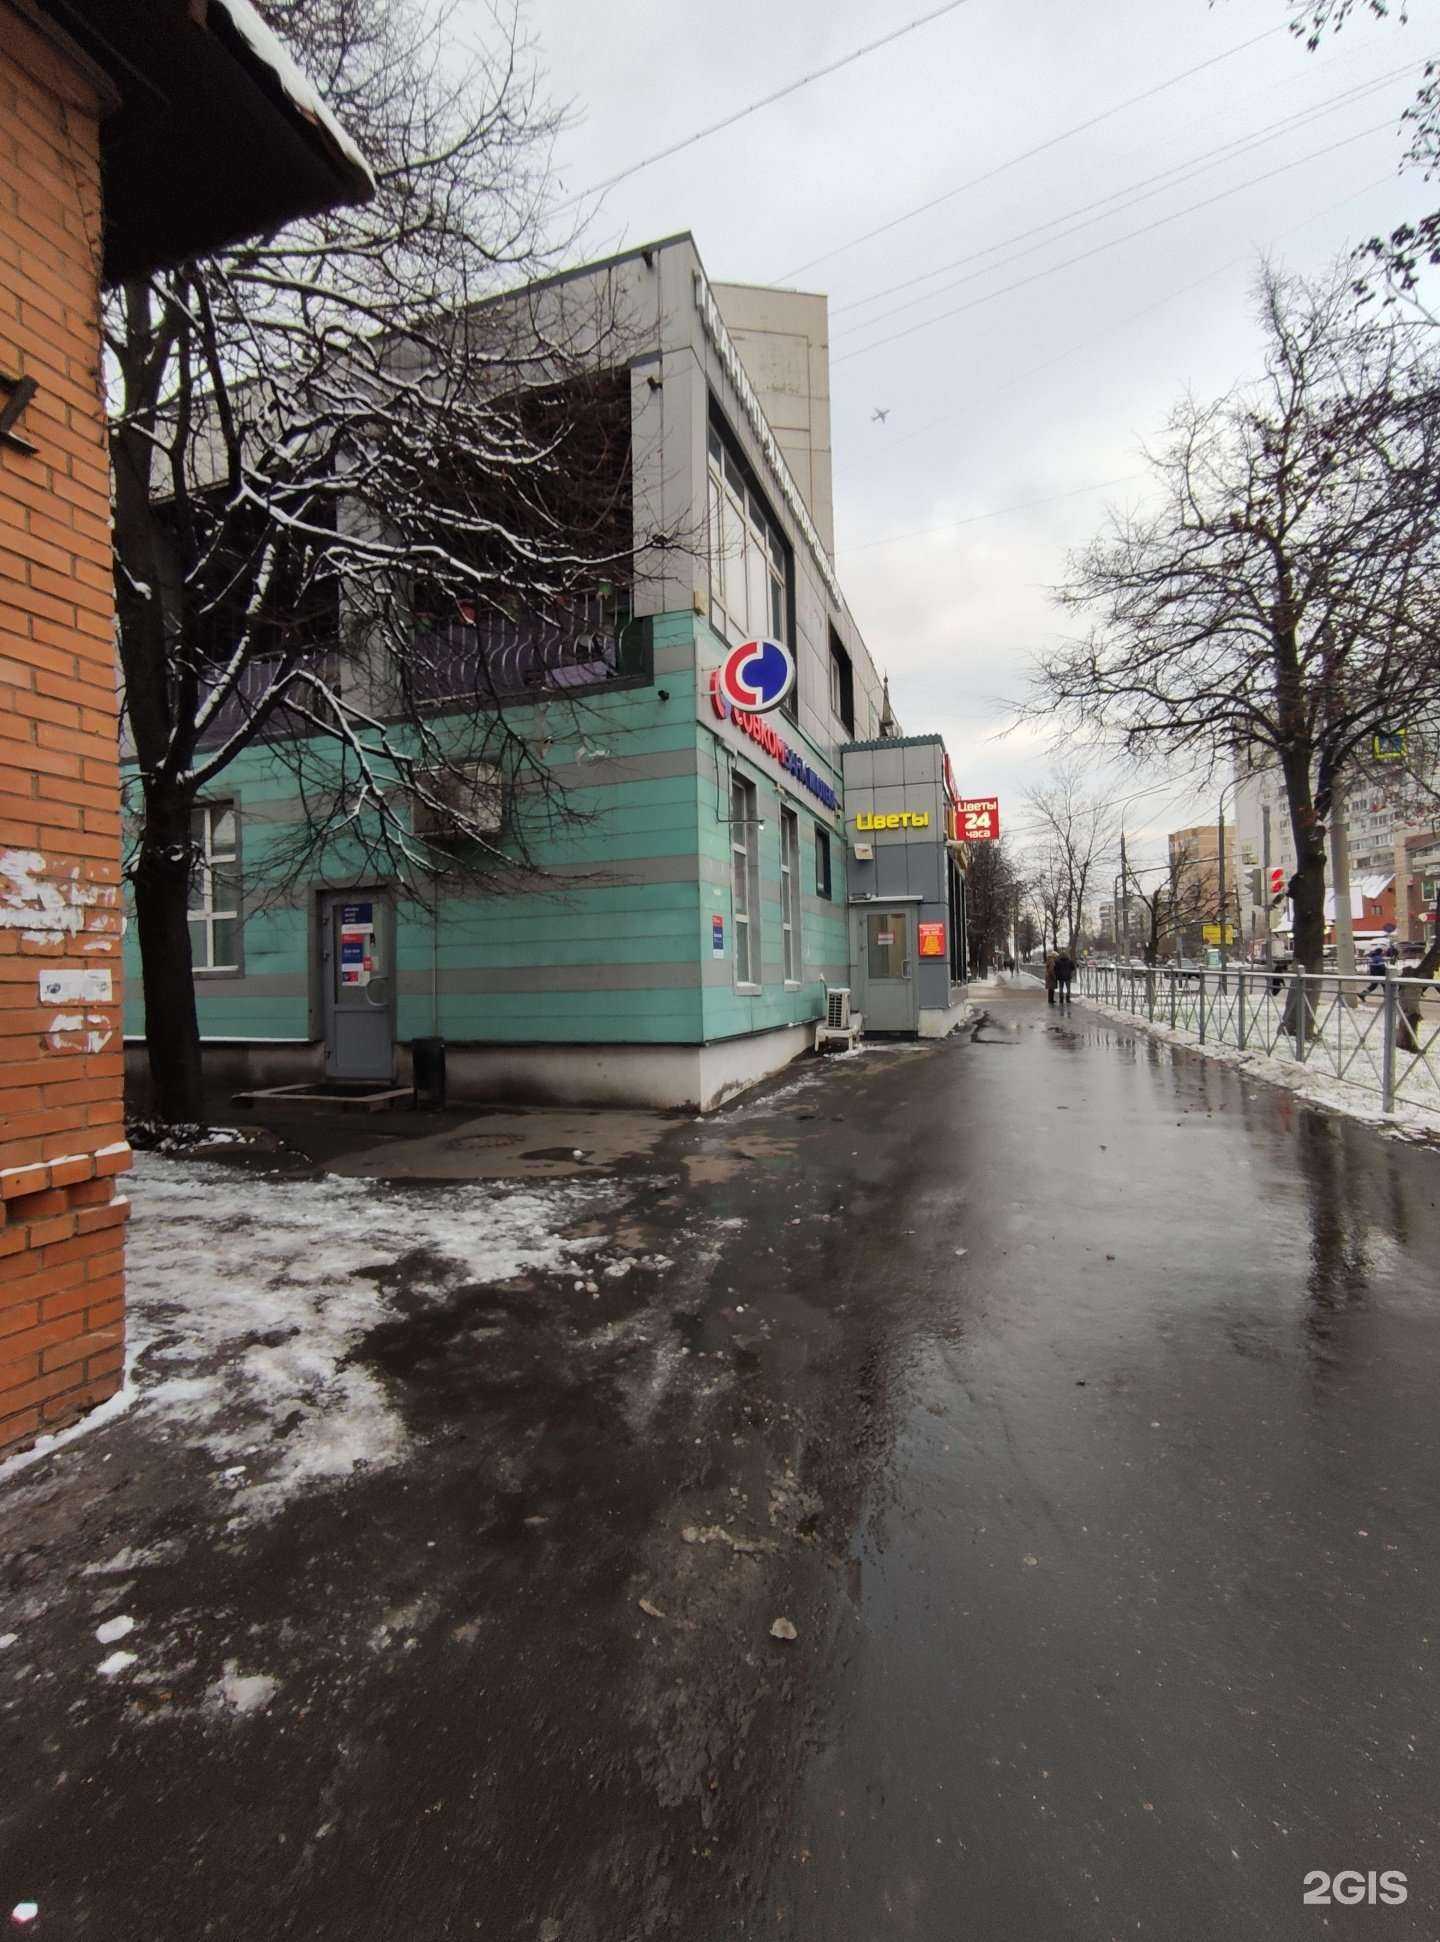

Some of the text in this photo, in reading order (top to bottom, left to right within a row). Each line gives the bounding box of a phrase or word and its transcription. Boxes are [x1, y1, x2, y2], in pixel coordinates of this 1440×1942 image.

[957, 801, 997, 813] Цветы
[856, 811, 929, 831] Цветы
[965, 812, 991, 830] 24
[965, 830, 991, 839] часа
